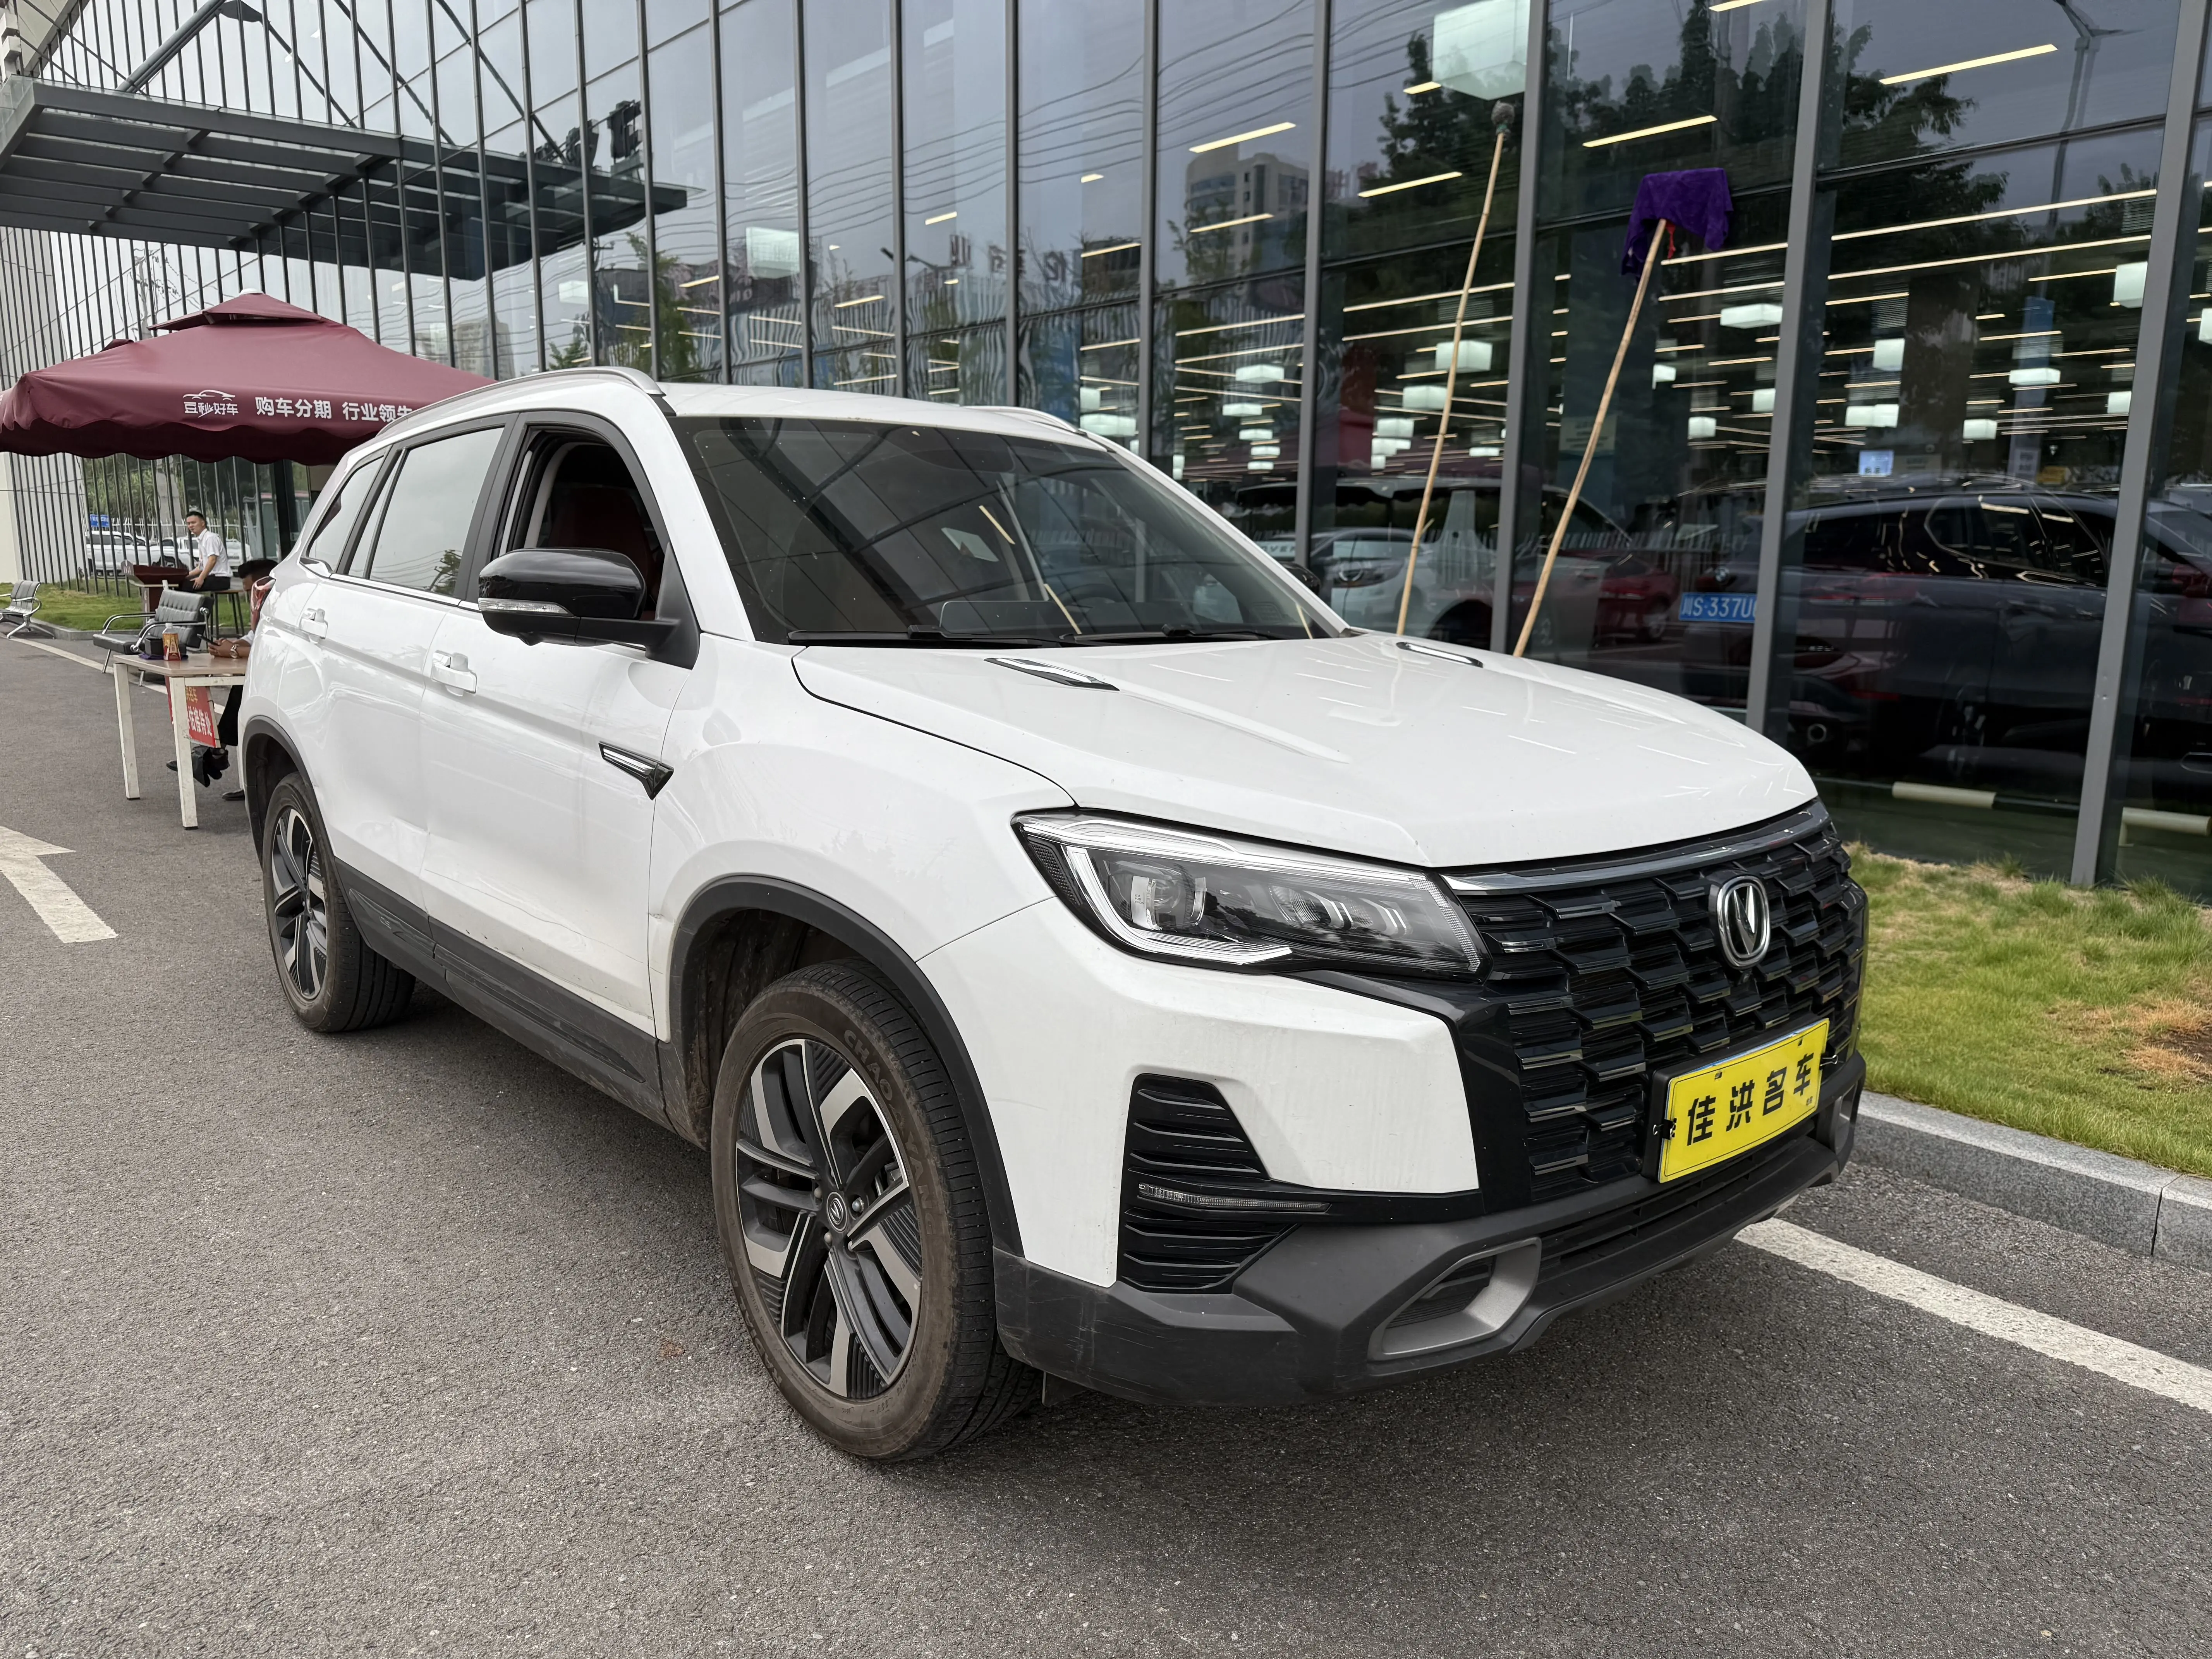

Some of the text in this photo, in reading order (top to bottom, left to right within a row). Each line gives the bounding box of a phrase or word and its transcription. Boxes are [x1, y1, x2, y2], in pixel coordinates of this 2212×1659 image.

[255, 396, 332, 419] 购车分期
[187, 706, 213, 737] 估接待处
[1687, 1053, 1814, 1146] 佳洪名车
[844, 1029, 936, 1235] CHAO YANG
